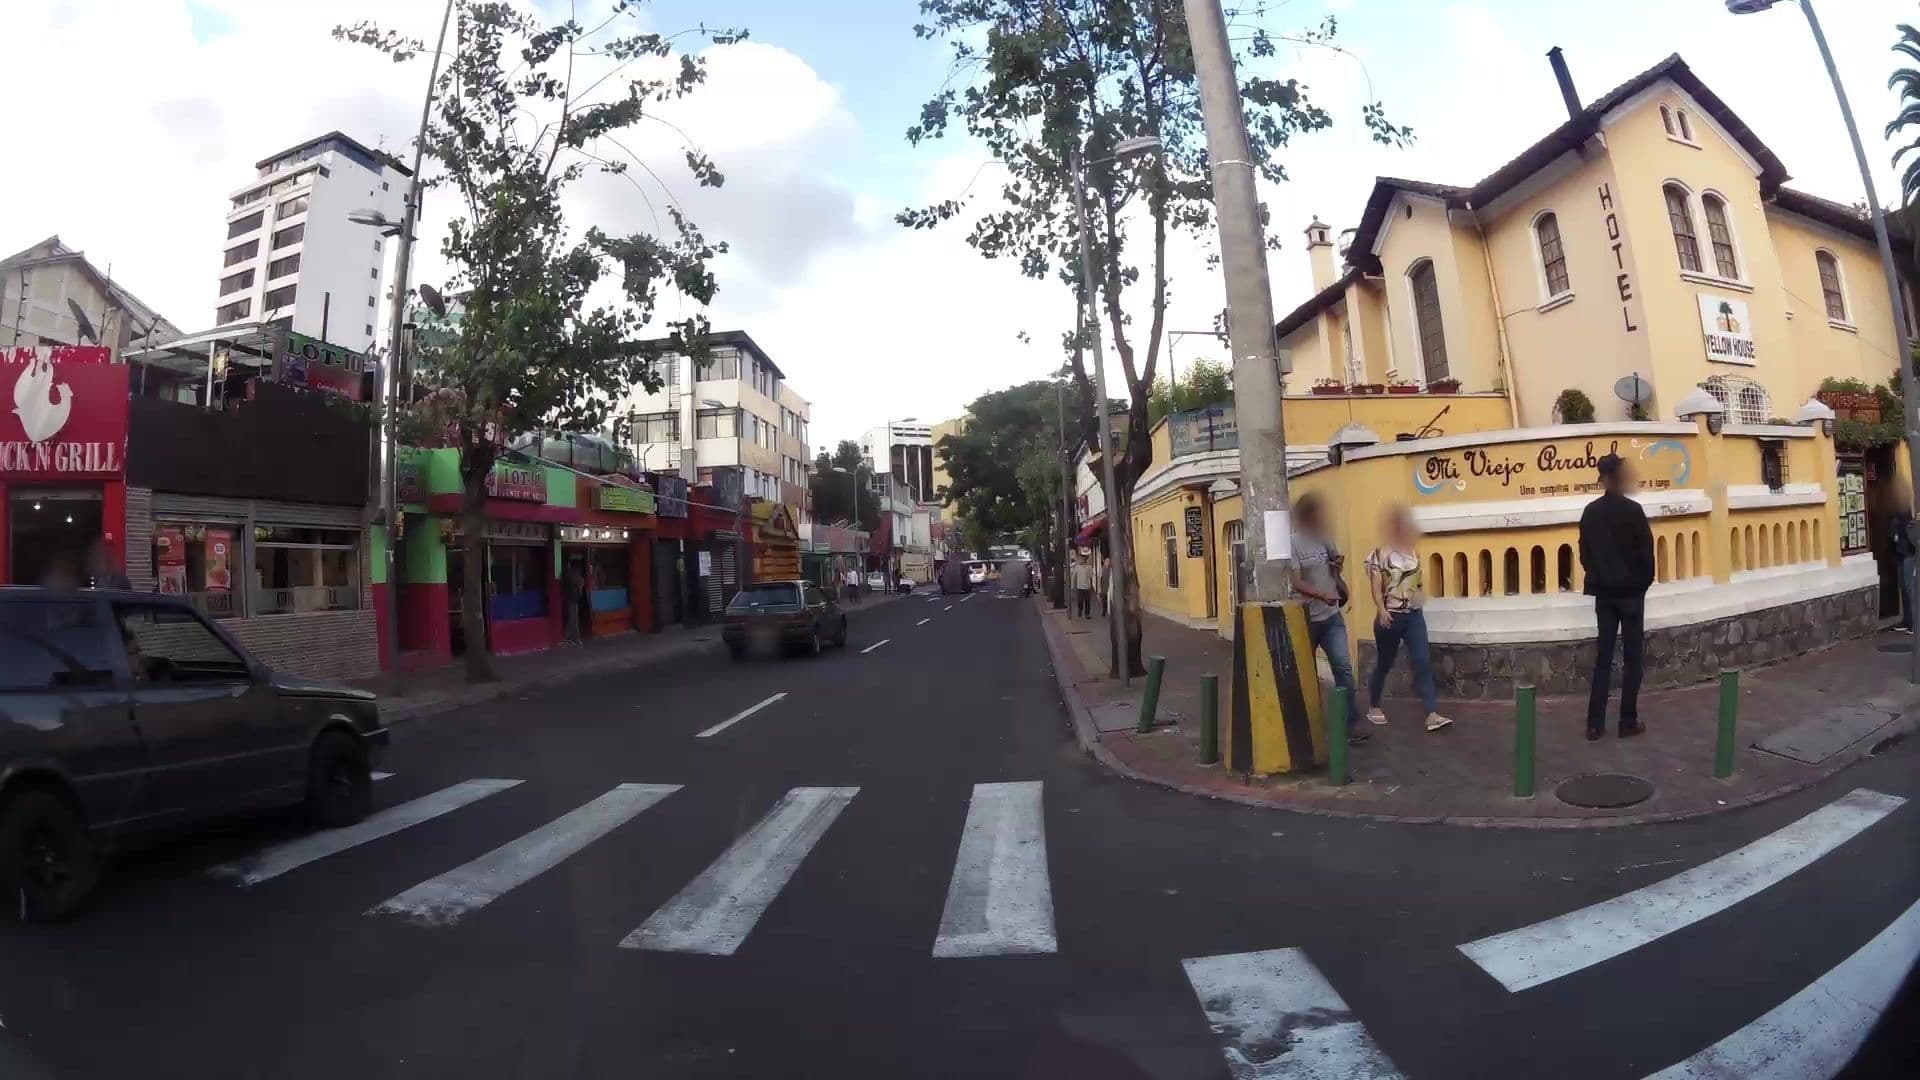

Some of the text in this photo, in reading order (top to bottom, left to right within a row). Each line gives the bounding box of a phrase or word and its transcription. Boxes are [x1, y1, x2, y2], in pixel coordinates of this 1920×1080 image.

[1598, 182, 1638, 332] HOTEL
[284, 338, 362, 375] LOT-10
[1704, 334, 1755, 359] YELLOW HOUSE
[55, 442, 120, 472] GRILL
[1426, 440, 1618, 487] Mi Viejo Arrabl
